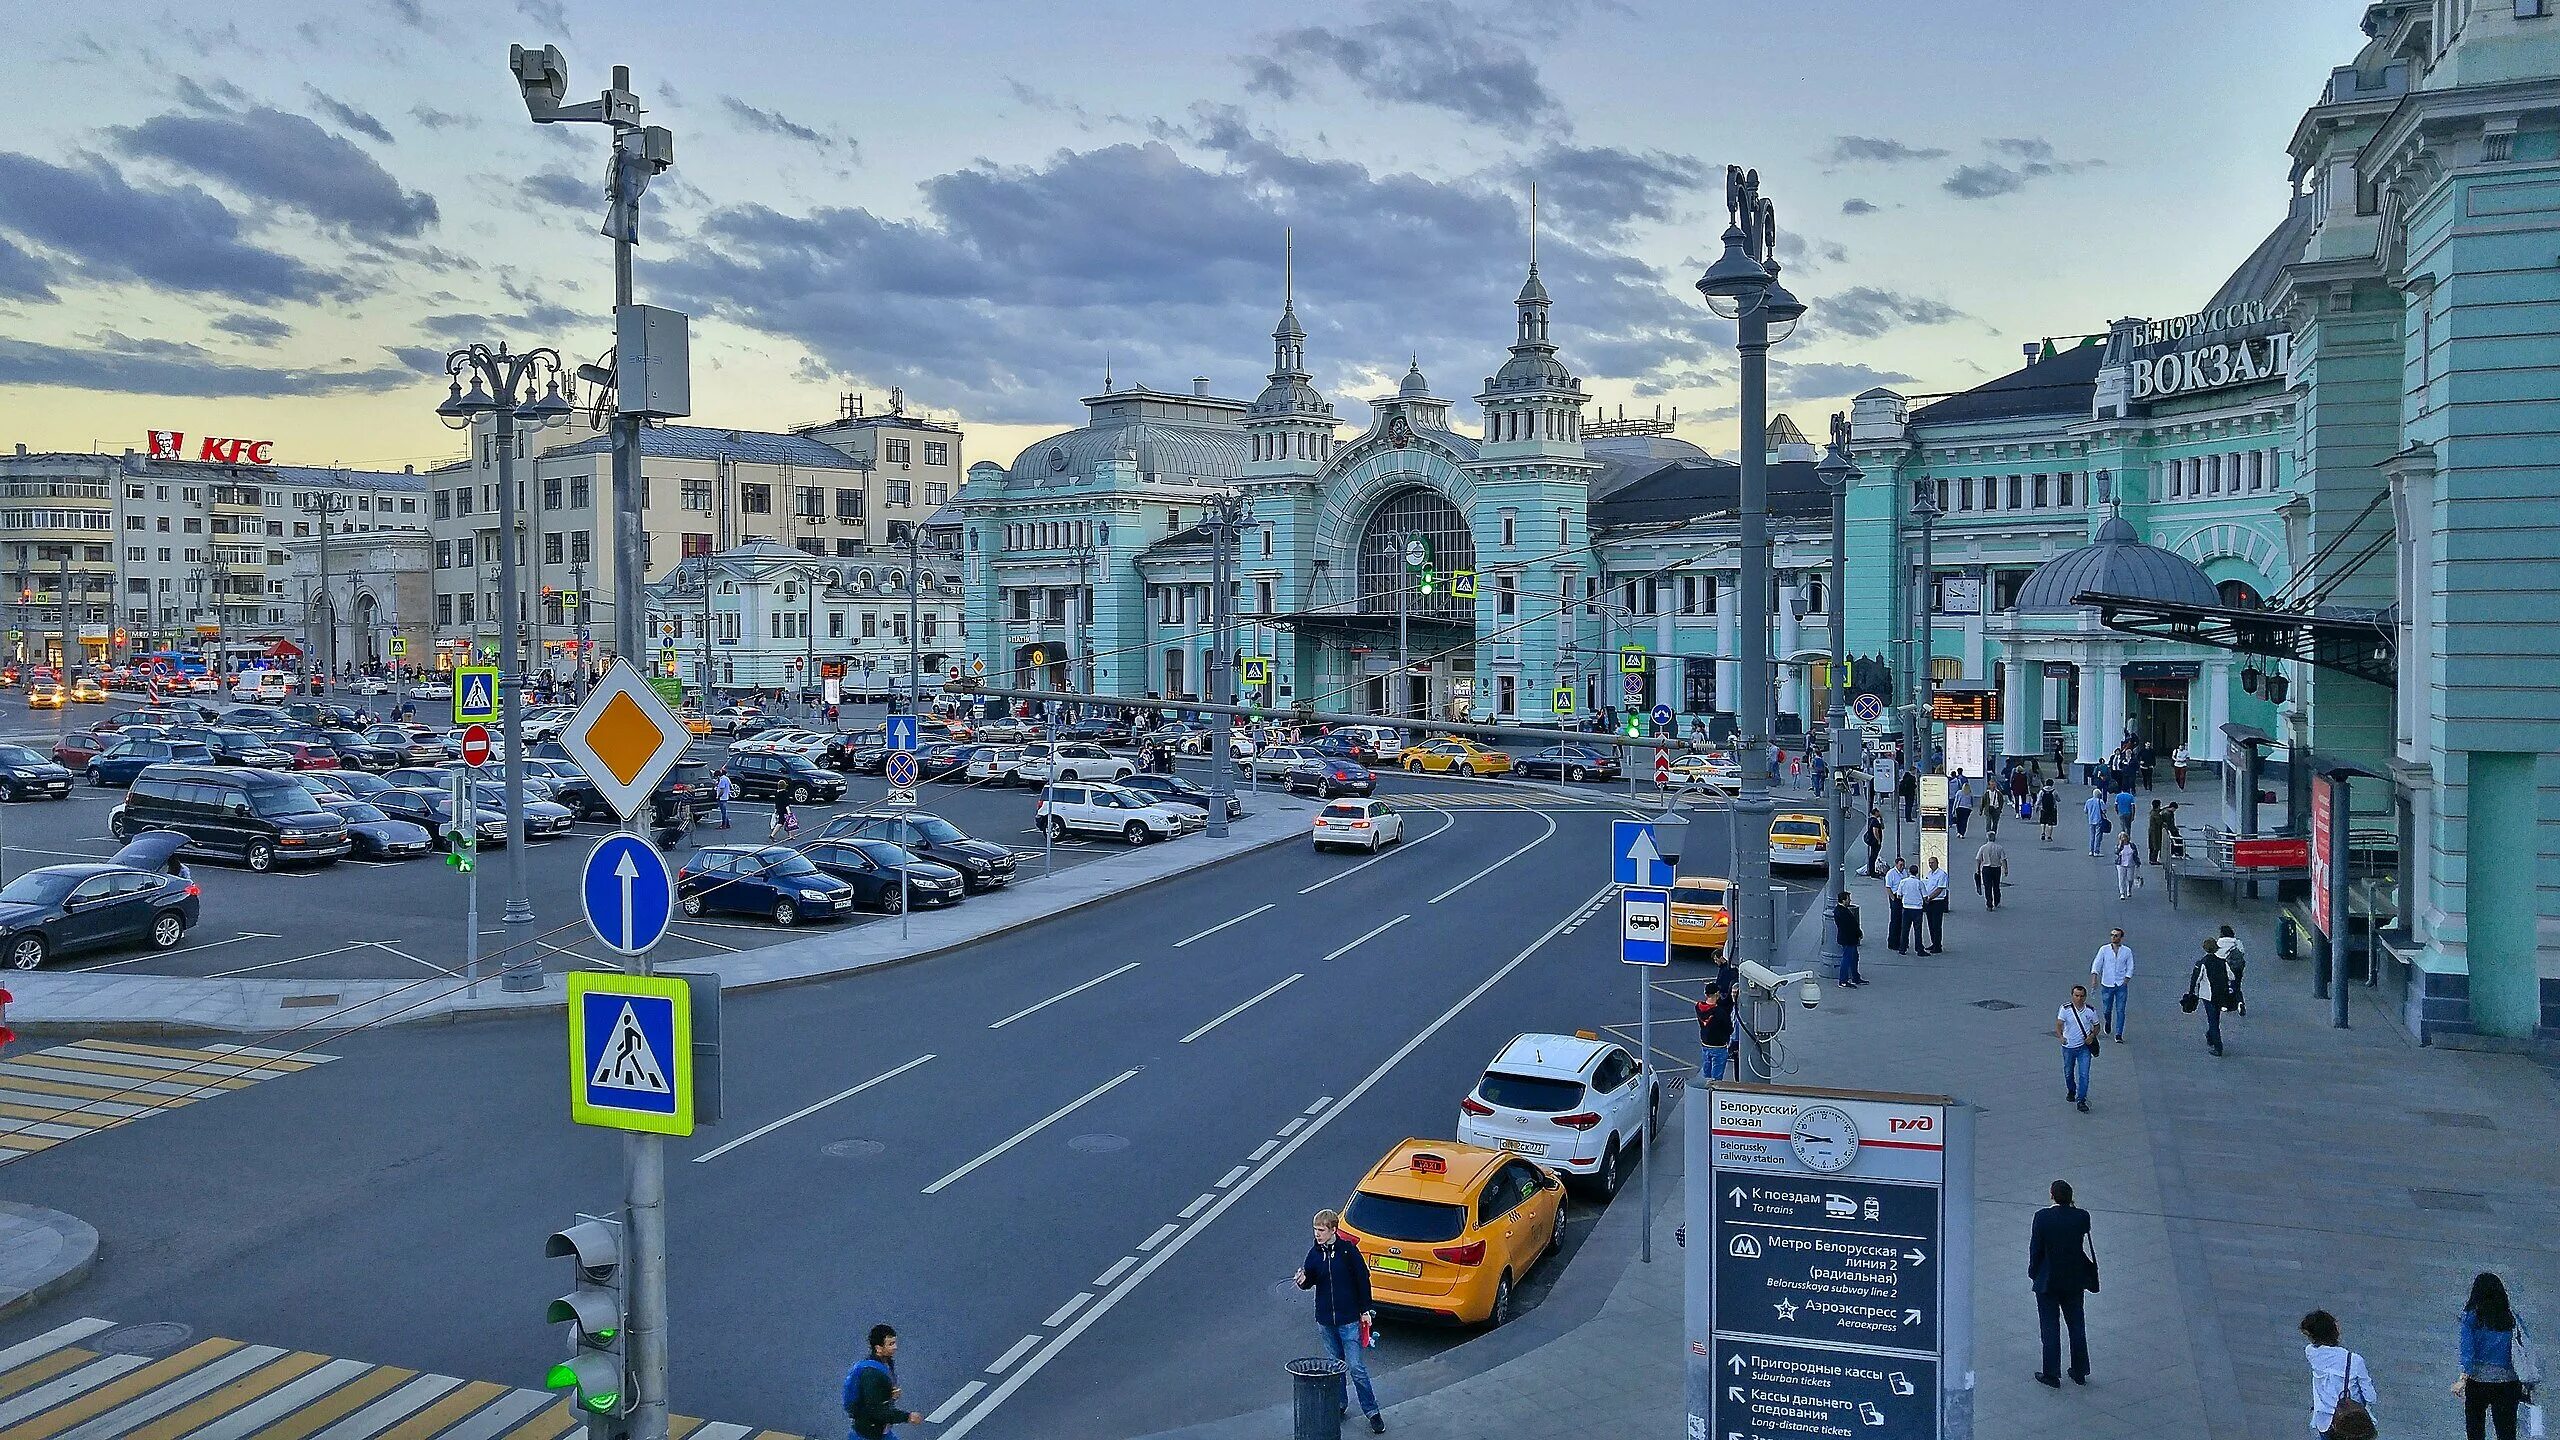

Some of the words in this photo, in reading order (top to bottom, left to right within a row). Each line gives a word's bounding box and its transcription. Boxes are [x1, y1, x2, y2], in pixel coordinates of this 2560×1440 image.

[2132, 300, 2275, 348] БЕЛОРУССКИ
[2130, 332, 2292, 398] ВОКЗАЛ
[200, 437, 274, 464] KFC
[1720, 1100, 1798, 1116] Белорусский
[1720, 1116, 1762, 1128] вокзал
[1720, 1141, 1767, 1153] Belorussky
[1418, 1160, 1437, 1170] TAXI
[1720, 1152, 1752, 1163] railway
[1753, 1155, 1785, 1164] station
[1752, 1187, 1761, 1199] К
[1764, 1190, 1821, 1204] поездам
[1752, 1203, 1764, 1212] To
[1766, 1204, 1794, 1215] trains
[1768, 1235, 1812, 1251] Метро
[1815, 1239, 1897, 1257] Белорусская
[1845, 1258, 1887, 1270] линия
[1890, 1259, 1898, 1271] 2
[1809, 1265, 1898, 1285] (радиальная)
[1767, 1277, 1829, 1292] Belorusskaya
[1831, 1284, 1870, 1297] subway
[1870, 1286, 1889, 1297] line
[1890, 1289, 1897, 1298] 2
[1805, 1299, 1897, 1319] Аэроэкспресс
[1837, 1318, 1897, 1332] Aeroexpress
[1751, 1355, 1841, 1375] Пригородные
[1845, 1367, 1883, 1380] кассы
[1752, 1371, 1799, 1384] Suburban
[1800, 1377, 1831, 1388] tickets
[1751, 1388, 1789, 1403] Кассы
[1792, 1395, 1853, 1410] дальнего
[1751, 1404, 1828, 1421] следования
[1752, 1417, 1819, 1433] Long-distance
[1821, 1425, 1853, 1437] tickets
